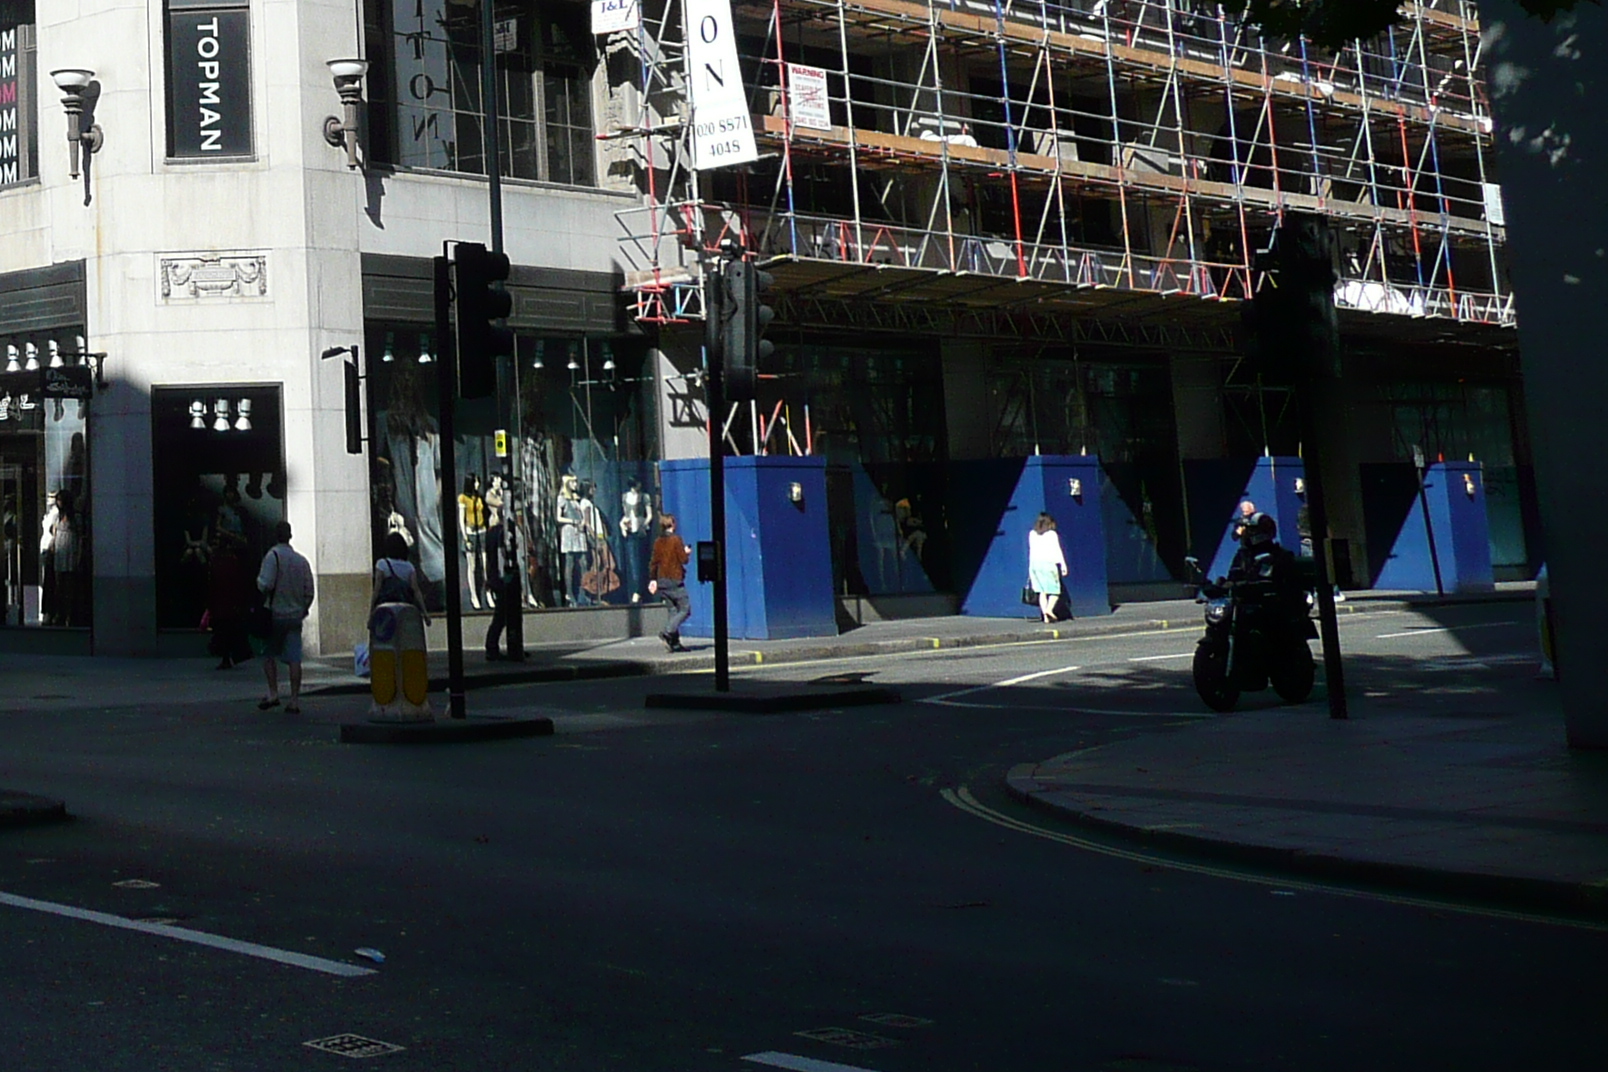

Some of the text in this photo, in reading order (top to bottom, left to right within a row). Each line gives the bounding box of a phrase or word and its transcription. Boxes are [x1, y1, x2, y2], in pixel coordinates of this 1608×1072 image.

[601, 0, 628, 13] J&L
[791, 66, 825, 80] WARNING
[197, 17, 222, 151] TOPMAN
[696, 121, 716, 138] 020
